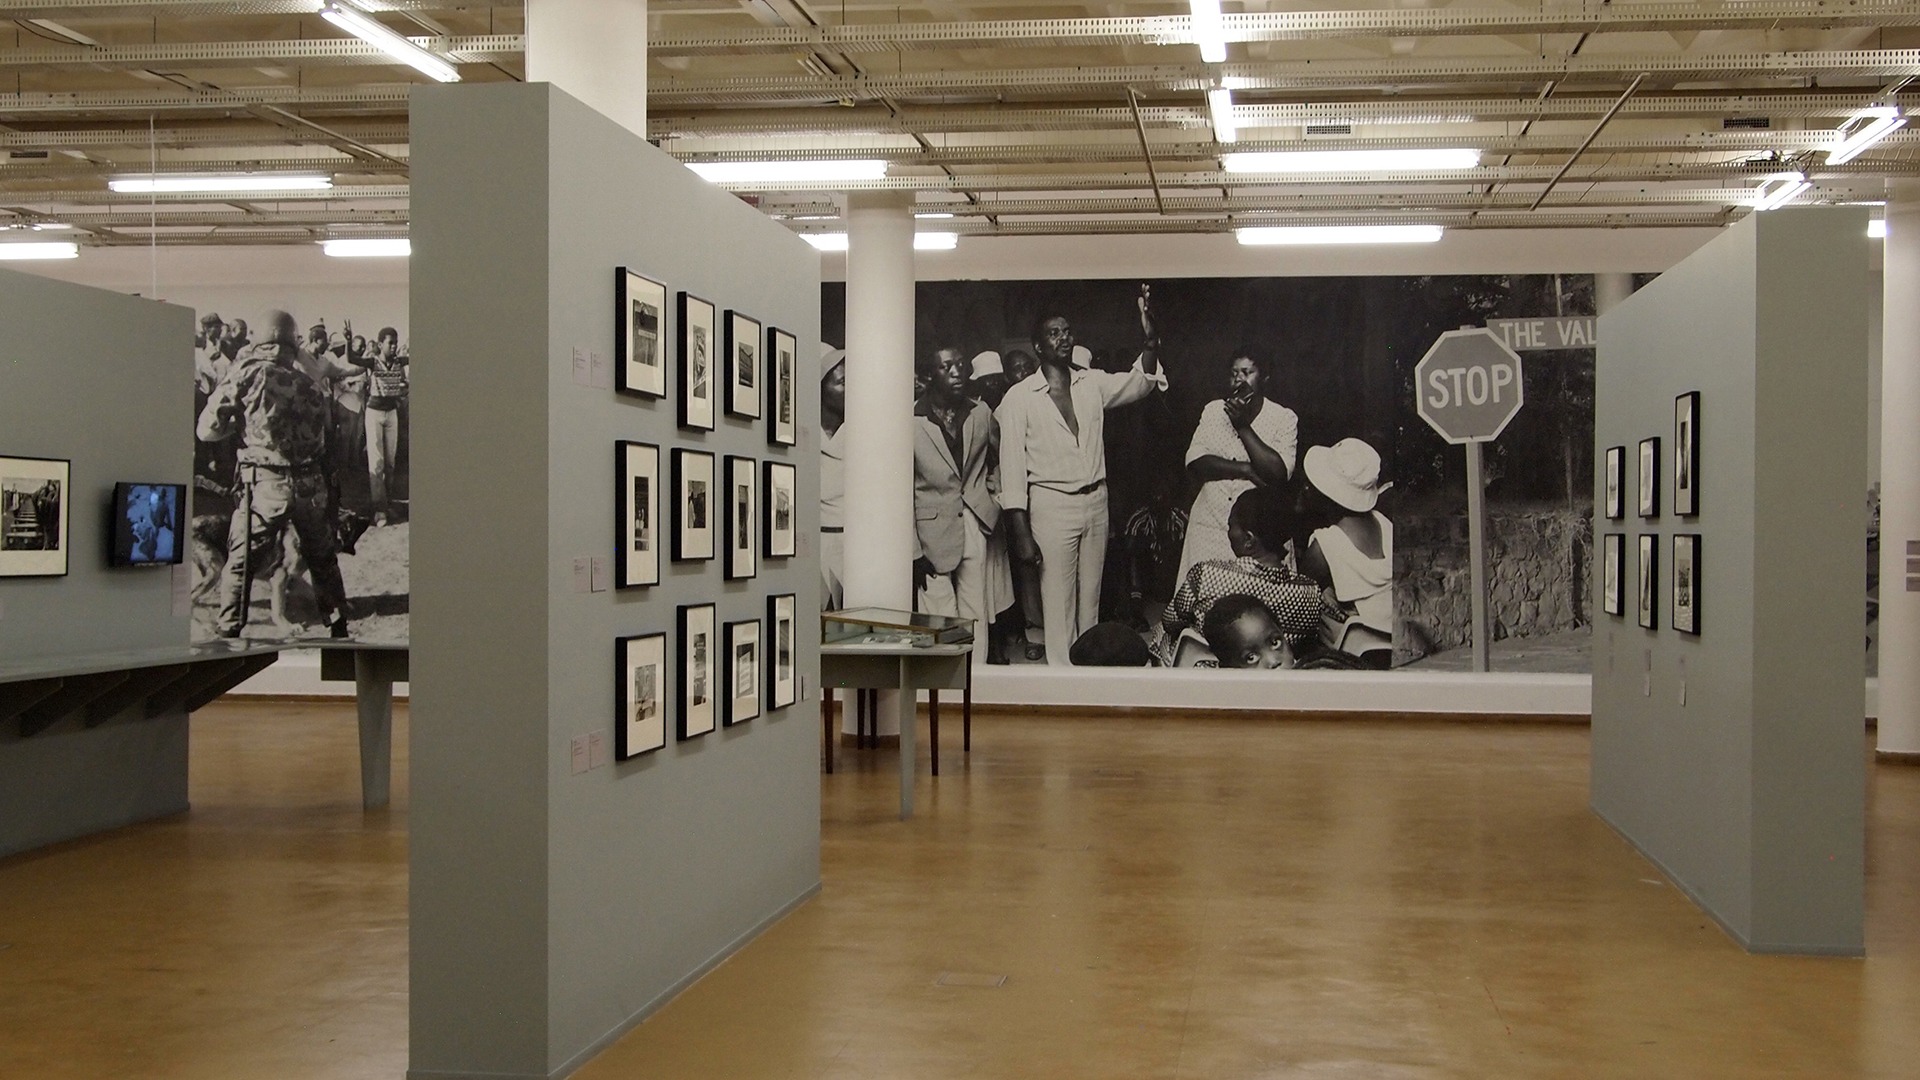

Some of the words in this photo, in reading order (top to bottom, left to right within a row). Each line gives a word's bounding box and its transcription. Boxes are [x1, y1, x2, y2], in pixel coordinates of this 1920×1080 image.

[1499, 321, 1546, 348] THE
[1556, 319, 1597, 346] VAL
[1428, 364, 1513, 409] STOP
